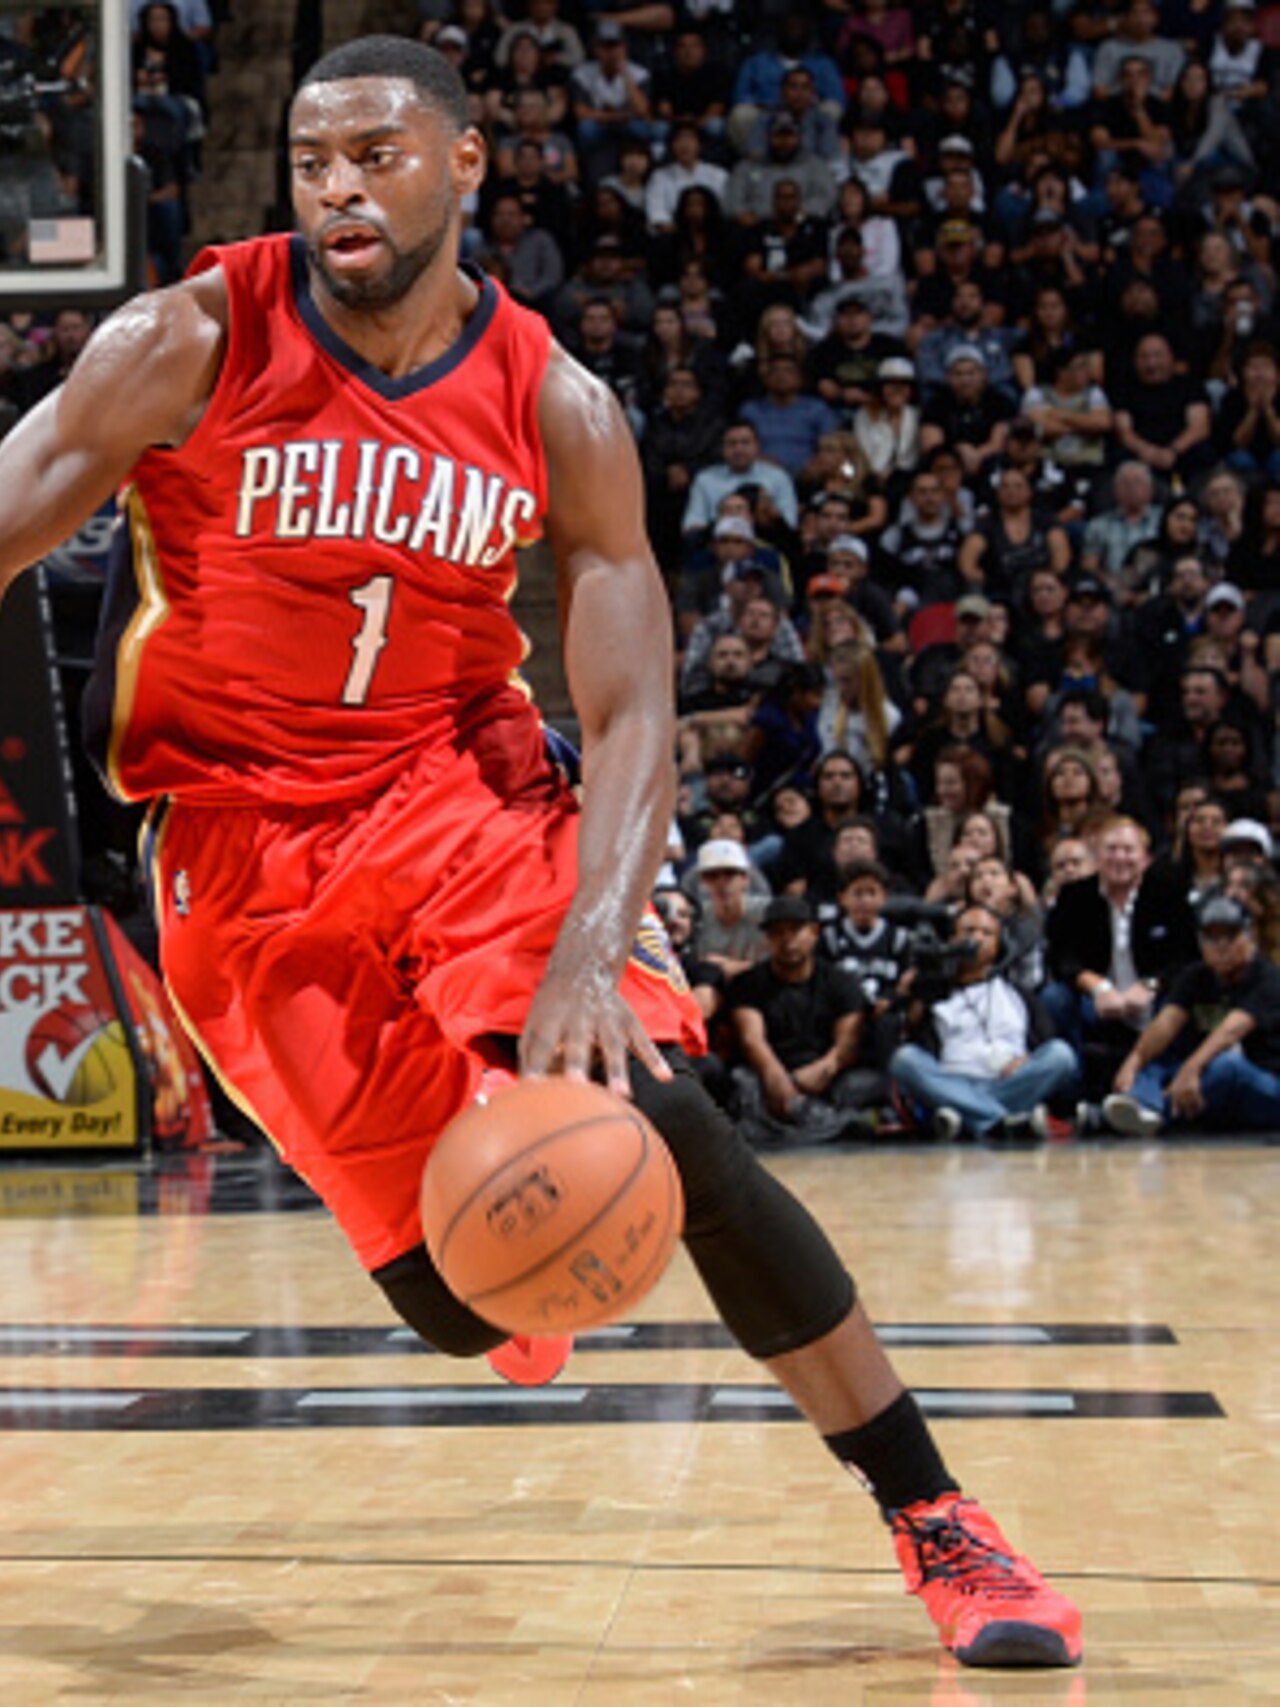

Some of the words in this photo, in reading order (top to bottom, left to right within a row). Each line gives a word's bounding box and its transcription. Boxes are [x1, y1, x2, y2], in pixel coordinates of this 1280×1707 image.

[235, 439, 536, 568] PELICANS
[341, 575, 395, 707] 1
[0, 1113, 65, 1138] Every
[71, 1111, 122, 1135] Day!
